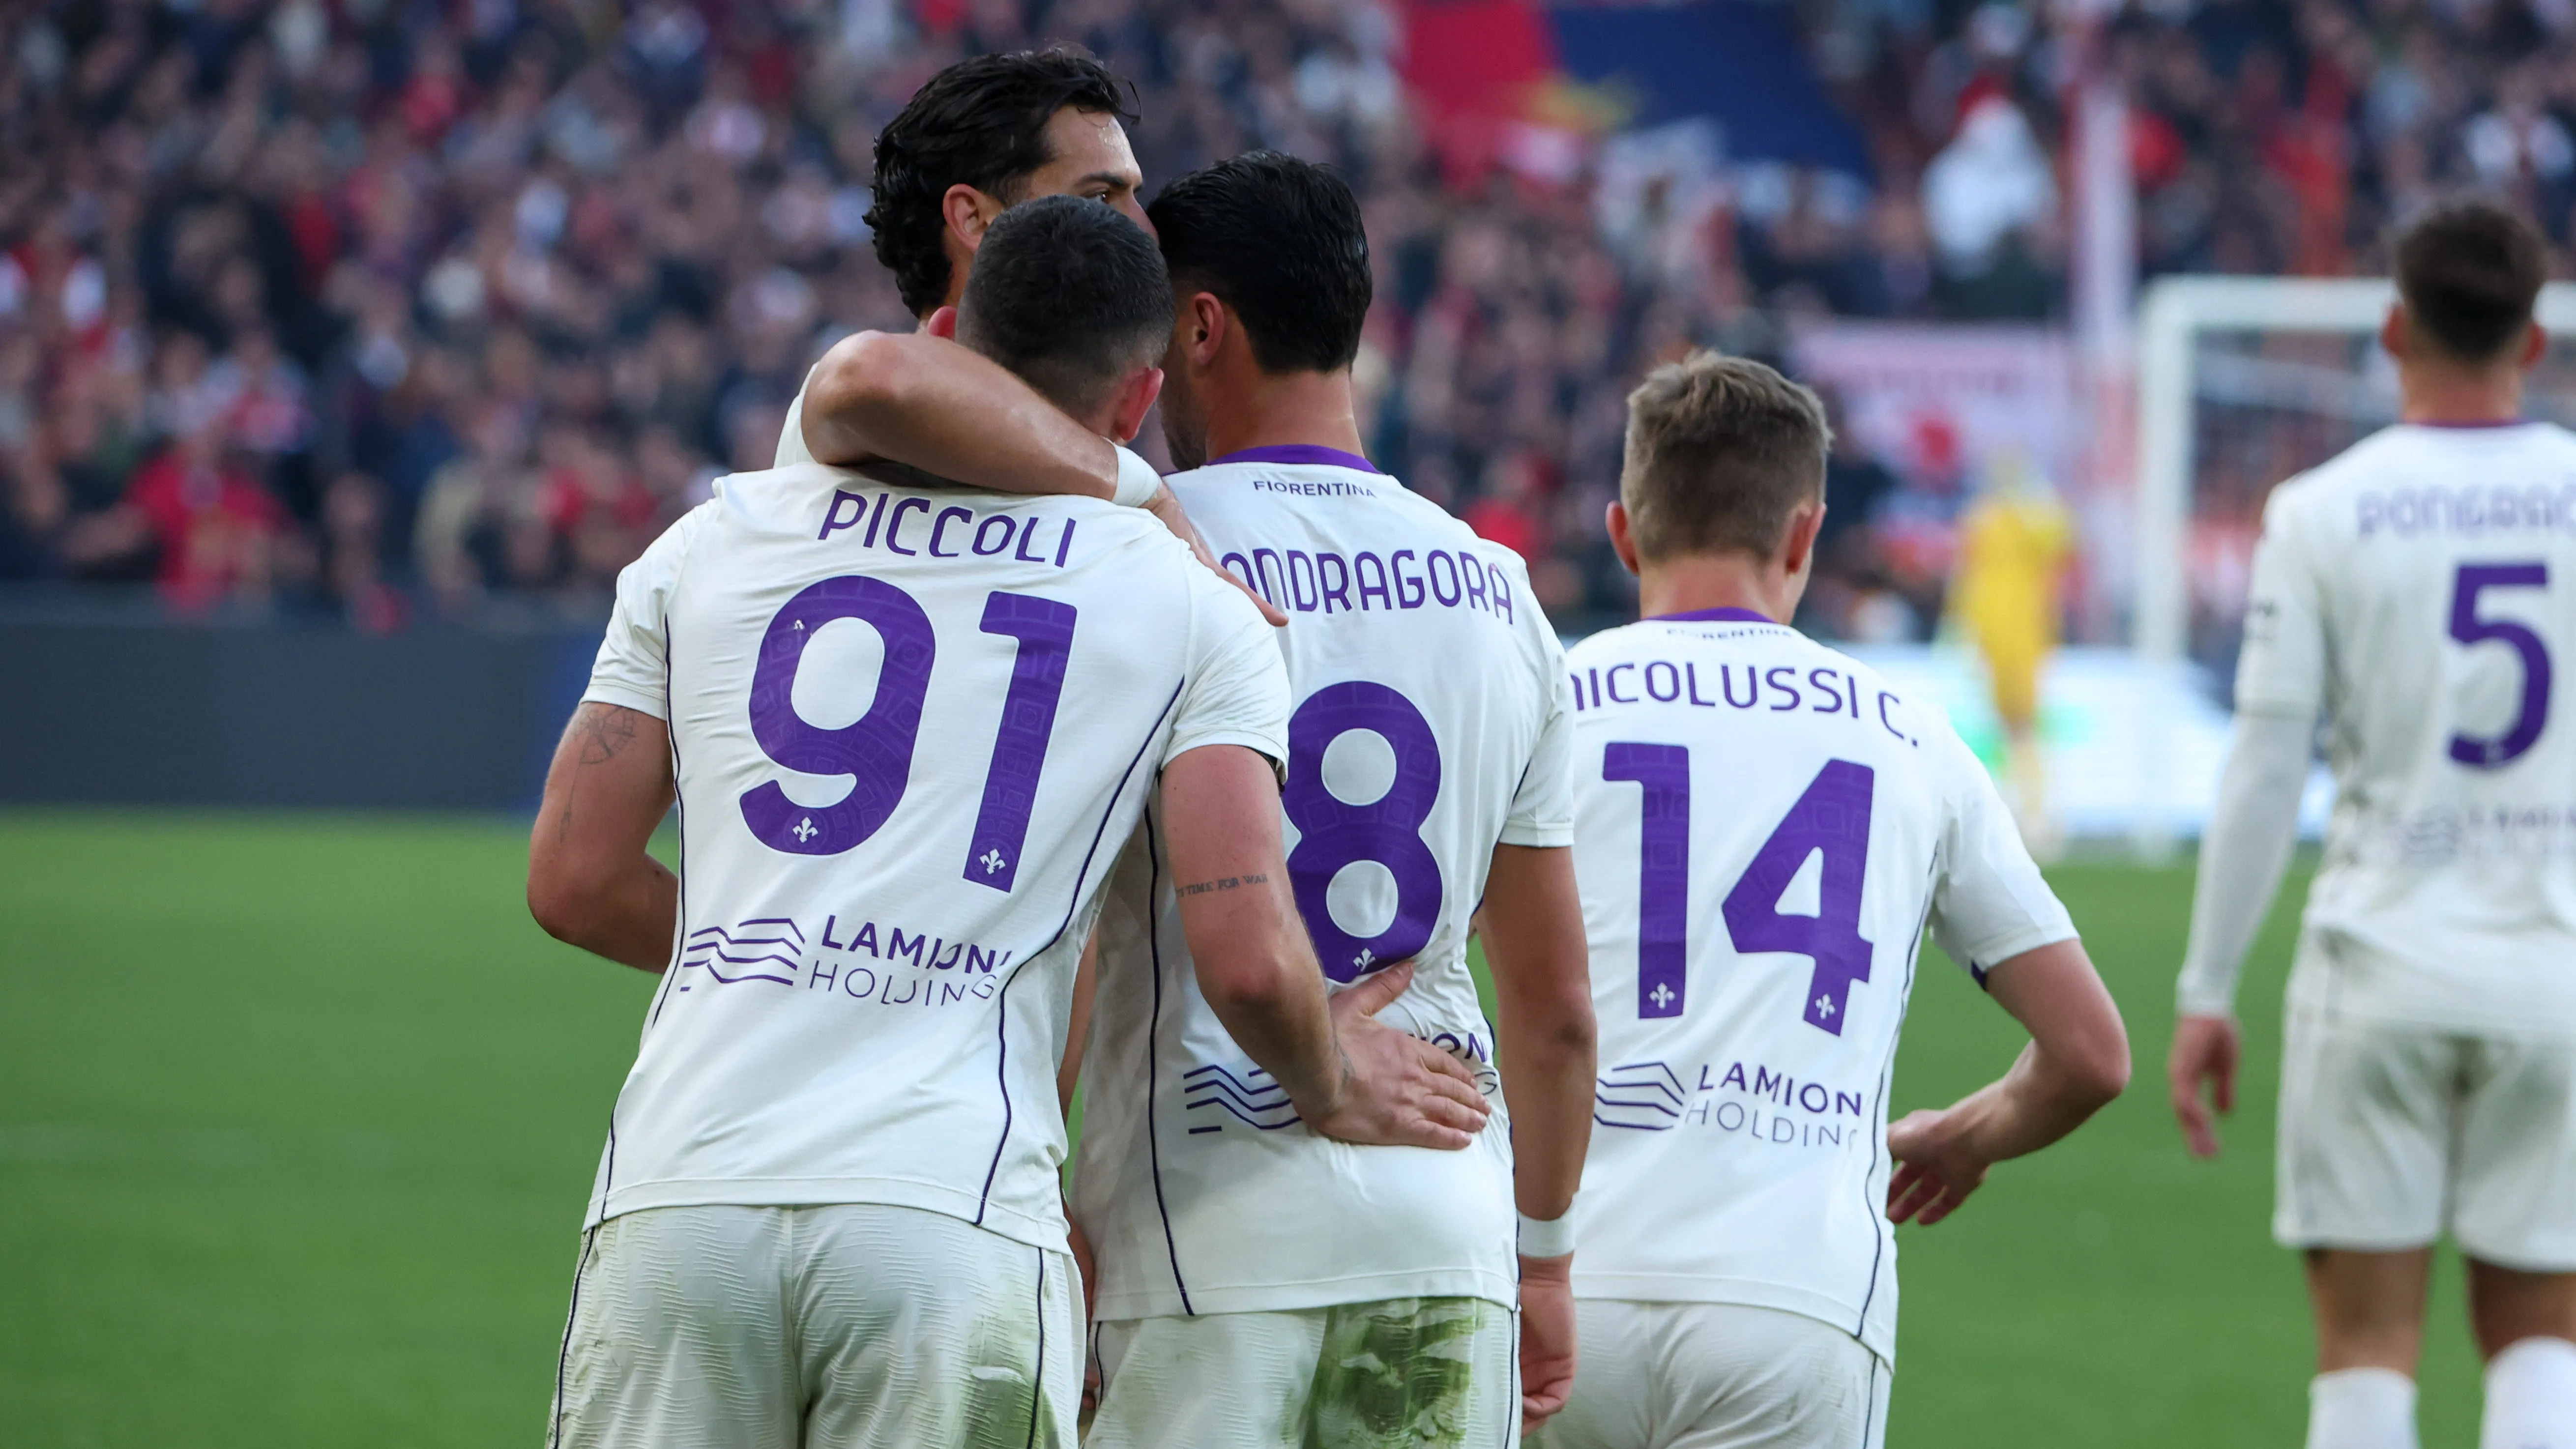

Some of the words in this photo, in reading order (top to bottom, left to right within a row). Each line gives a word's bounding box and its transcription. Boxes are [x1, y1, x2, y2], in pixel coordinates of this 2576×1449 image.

[818, 489, 1076, 567] PICCOLI
[1253, 481, 1377, 498] FIORENTINA
[2447, 562, 2552, 770] 5
[739, 575, 1077, 893] 91
[1878, 692, 1918, 747] C.
[1283, 680, 1442, 983] 8
[1186, 881, 1213, 895] TIME
[1217, 877, 1240, 890] FOR
[1242, 874, 1268, 885] WAR
[1603, 742, 1874, 1037] 14
[1698, 1061, 1861, 1116] LAMION
